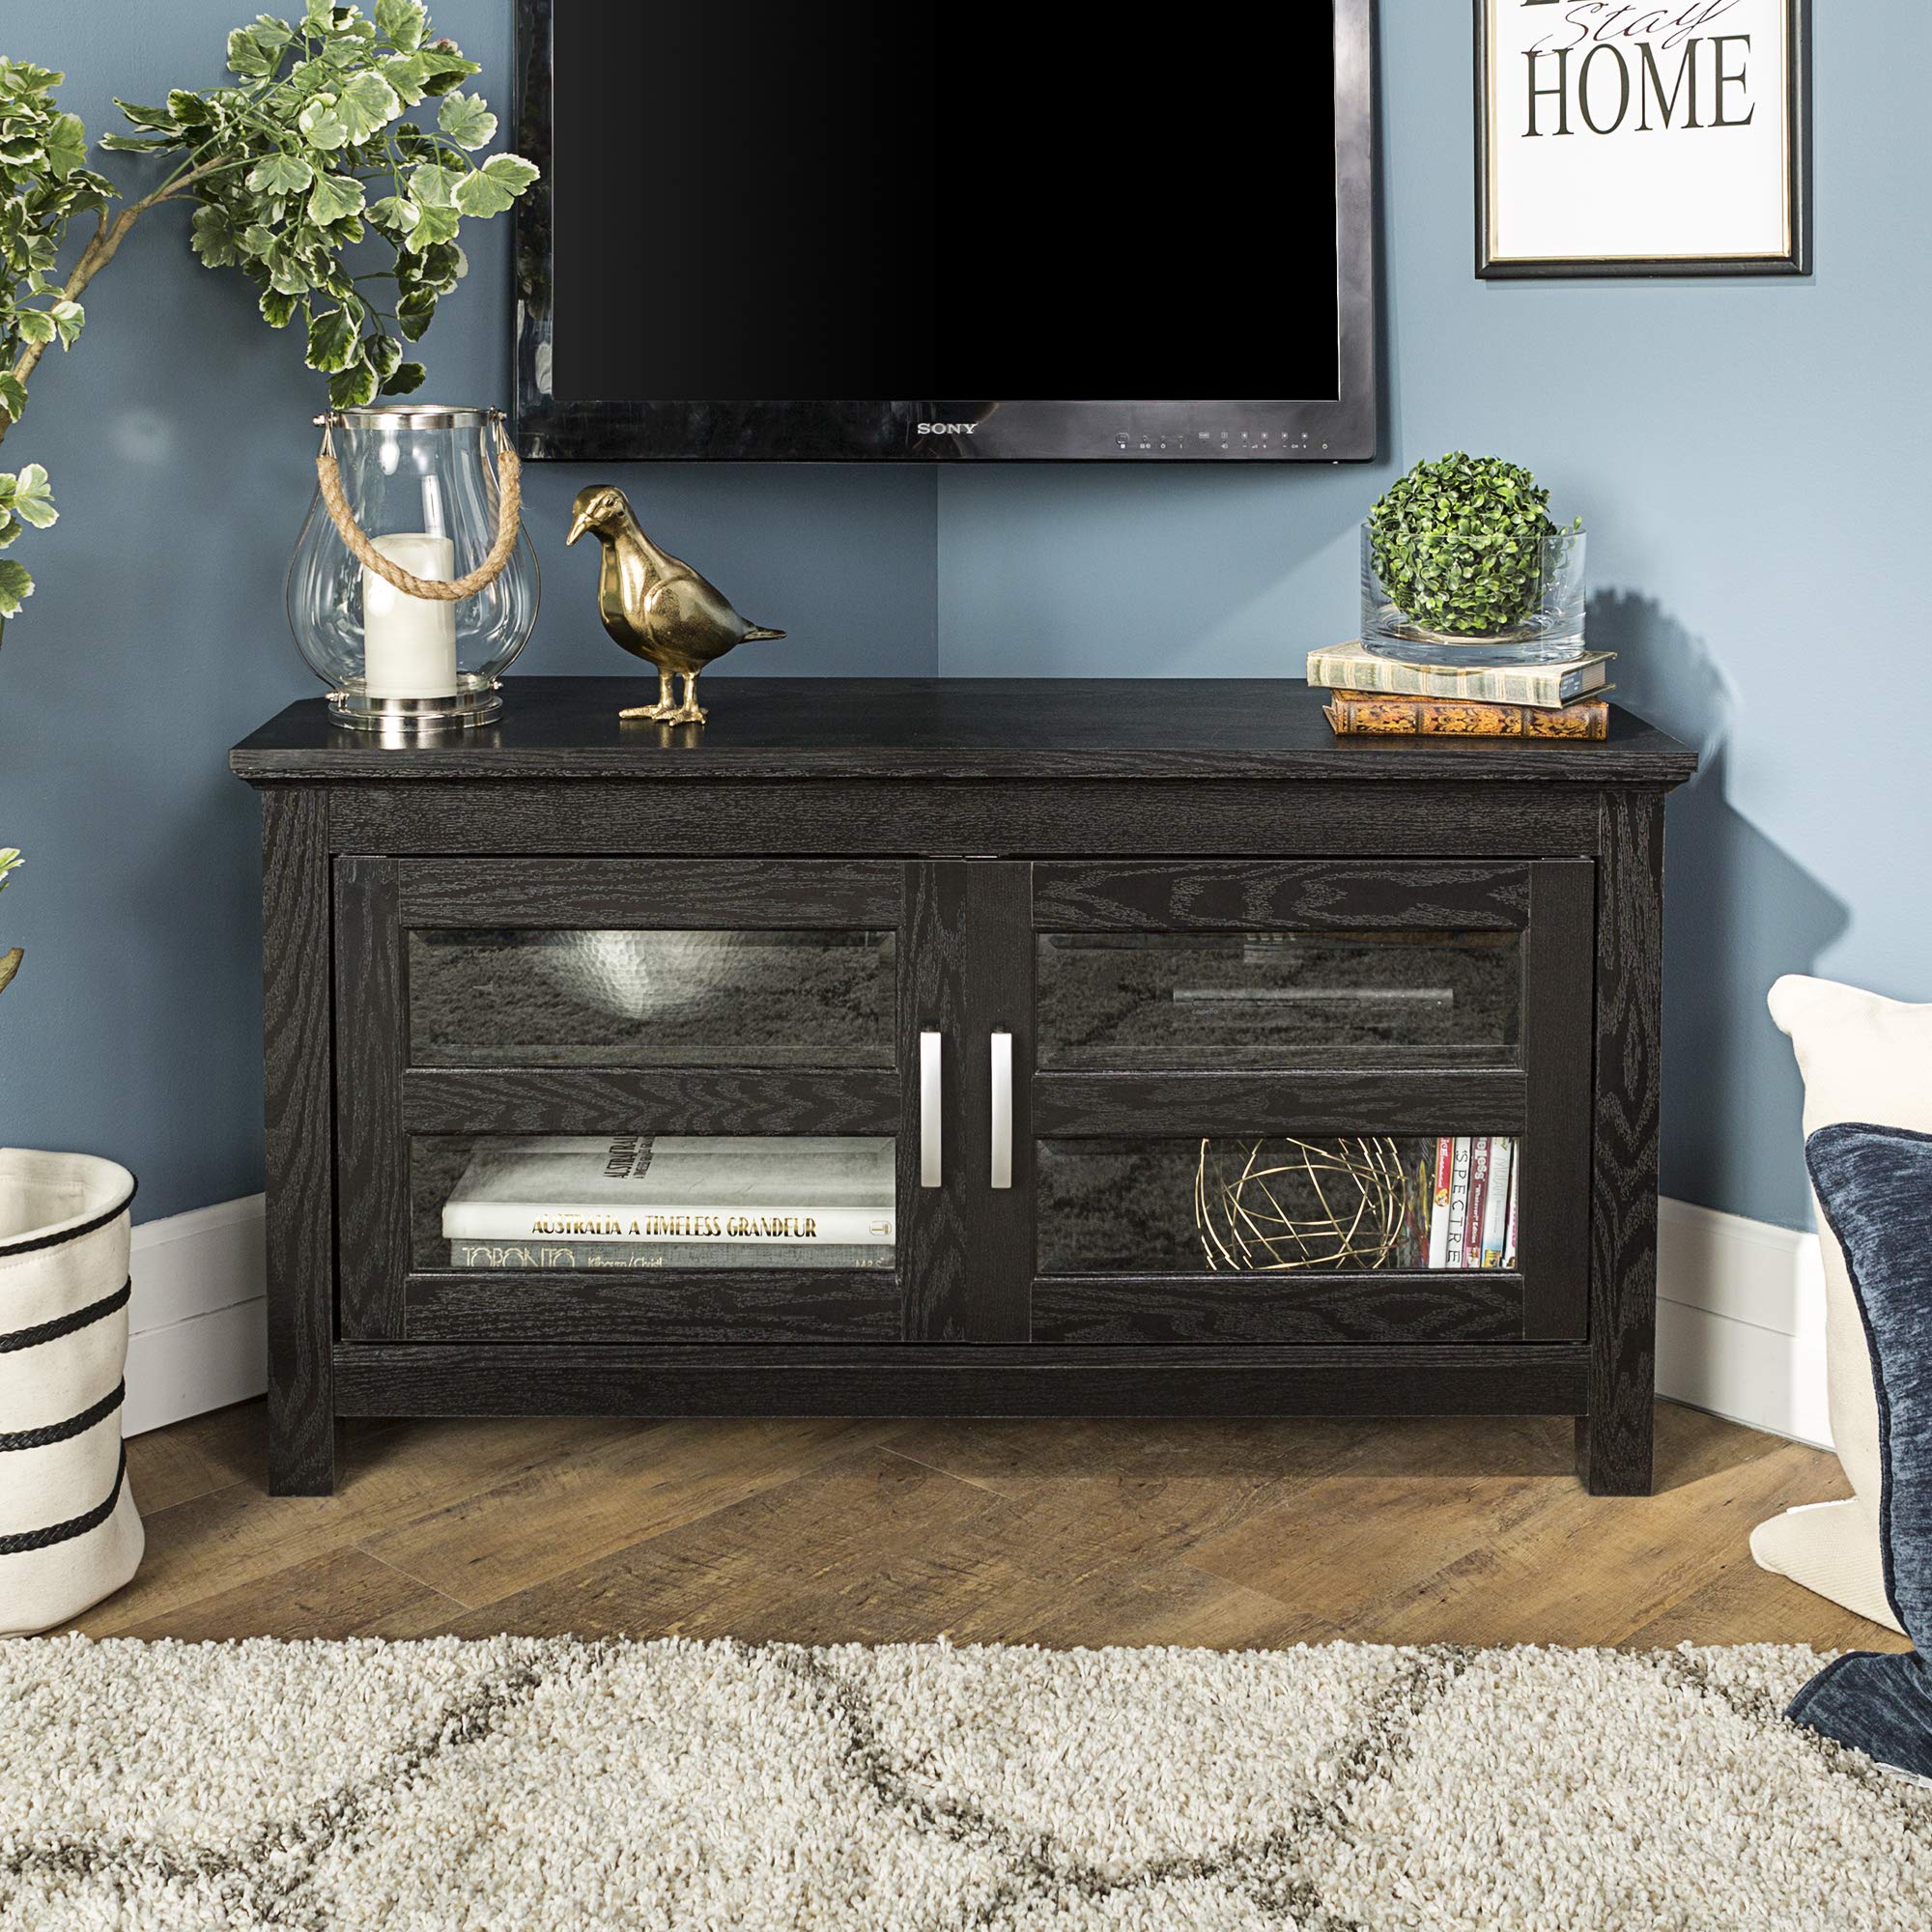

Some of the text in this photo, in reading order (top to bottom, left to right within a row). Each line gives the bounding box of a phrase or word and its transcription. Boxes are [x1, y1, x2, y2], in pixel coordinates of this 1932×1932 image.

[1528, 0, 1740, 57] Stay
[1521, 34, 1755, 137] HOME
[917, 422, 979, 435] SONY
[531, 1213, 817, 1237] AUSTRALIA A TIMELESS GRANDEUR
[1447, 1151, 1468, 1264] SPECTRE
[462, 1247, 576, 1267] TORONTO
